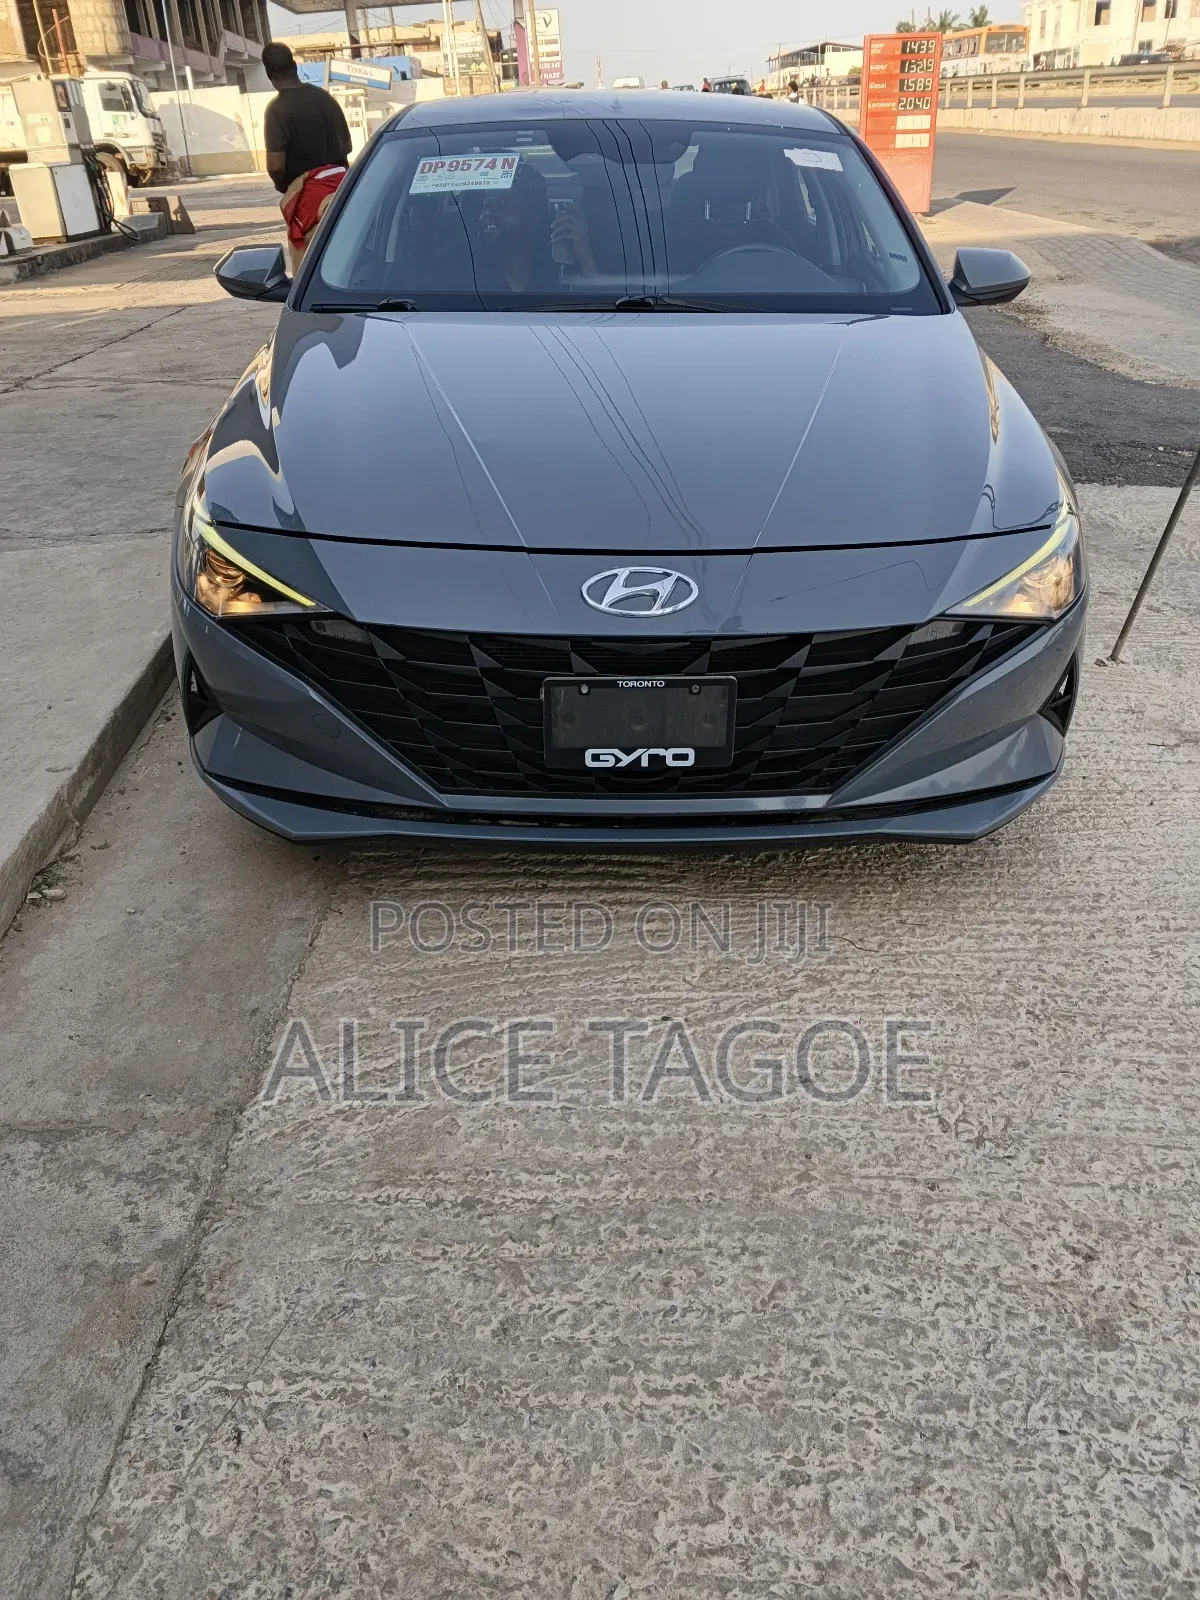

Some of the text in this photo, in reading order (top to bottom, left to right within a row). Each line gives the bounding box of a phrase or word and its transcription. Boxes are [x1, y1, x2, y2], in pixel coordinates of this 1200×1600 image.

[346, 64, 375, 77] TOTAL
[420, 158, 515, 174] DP 9574 N
[616, 680, 665, 688] TORONTO
